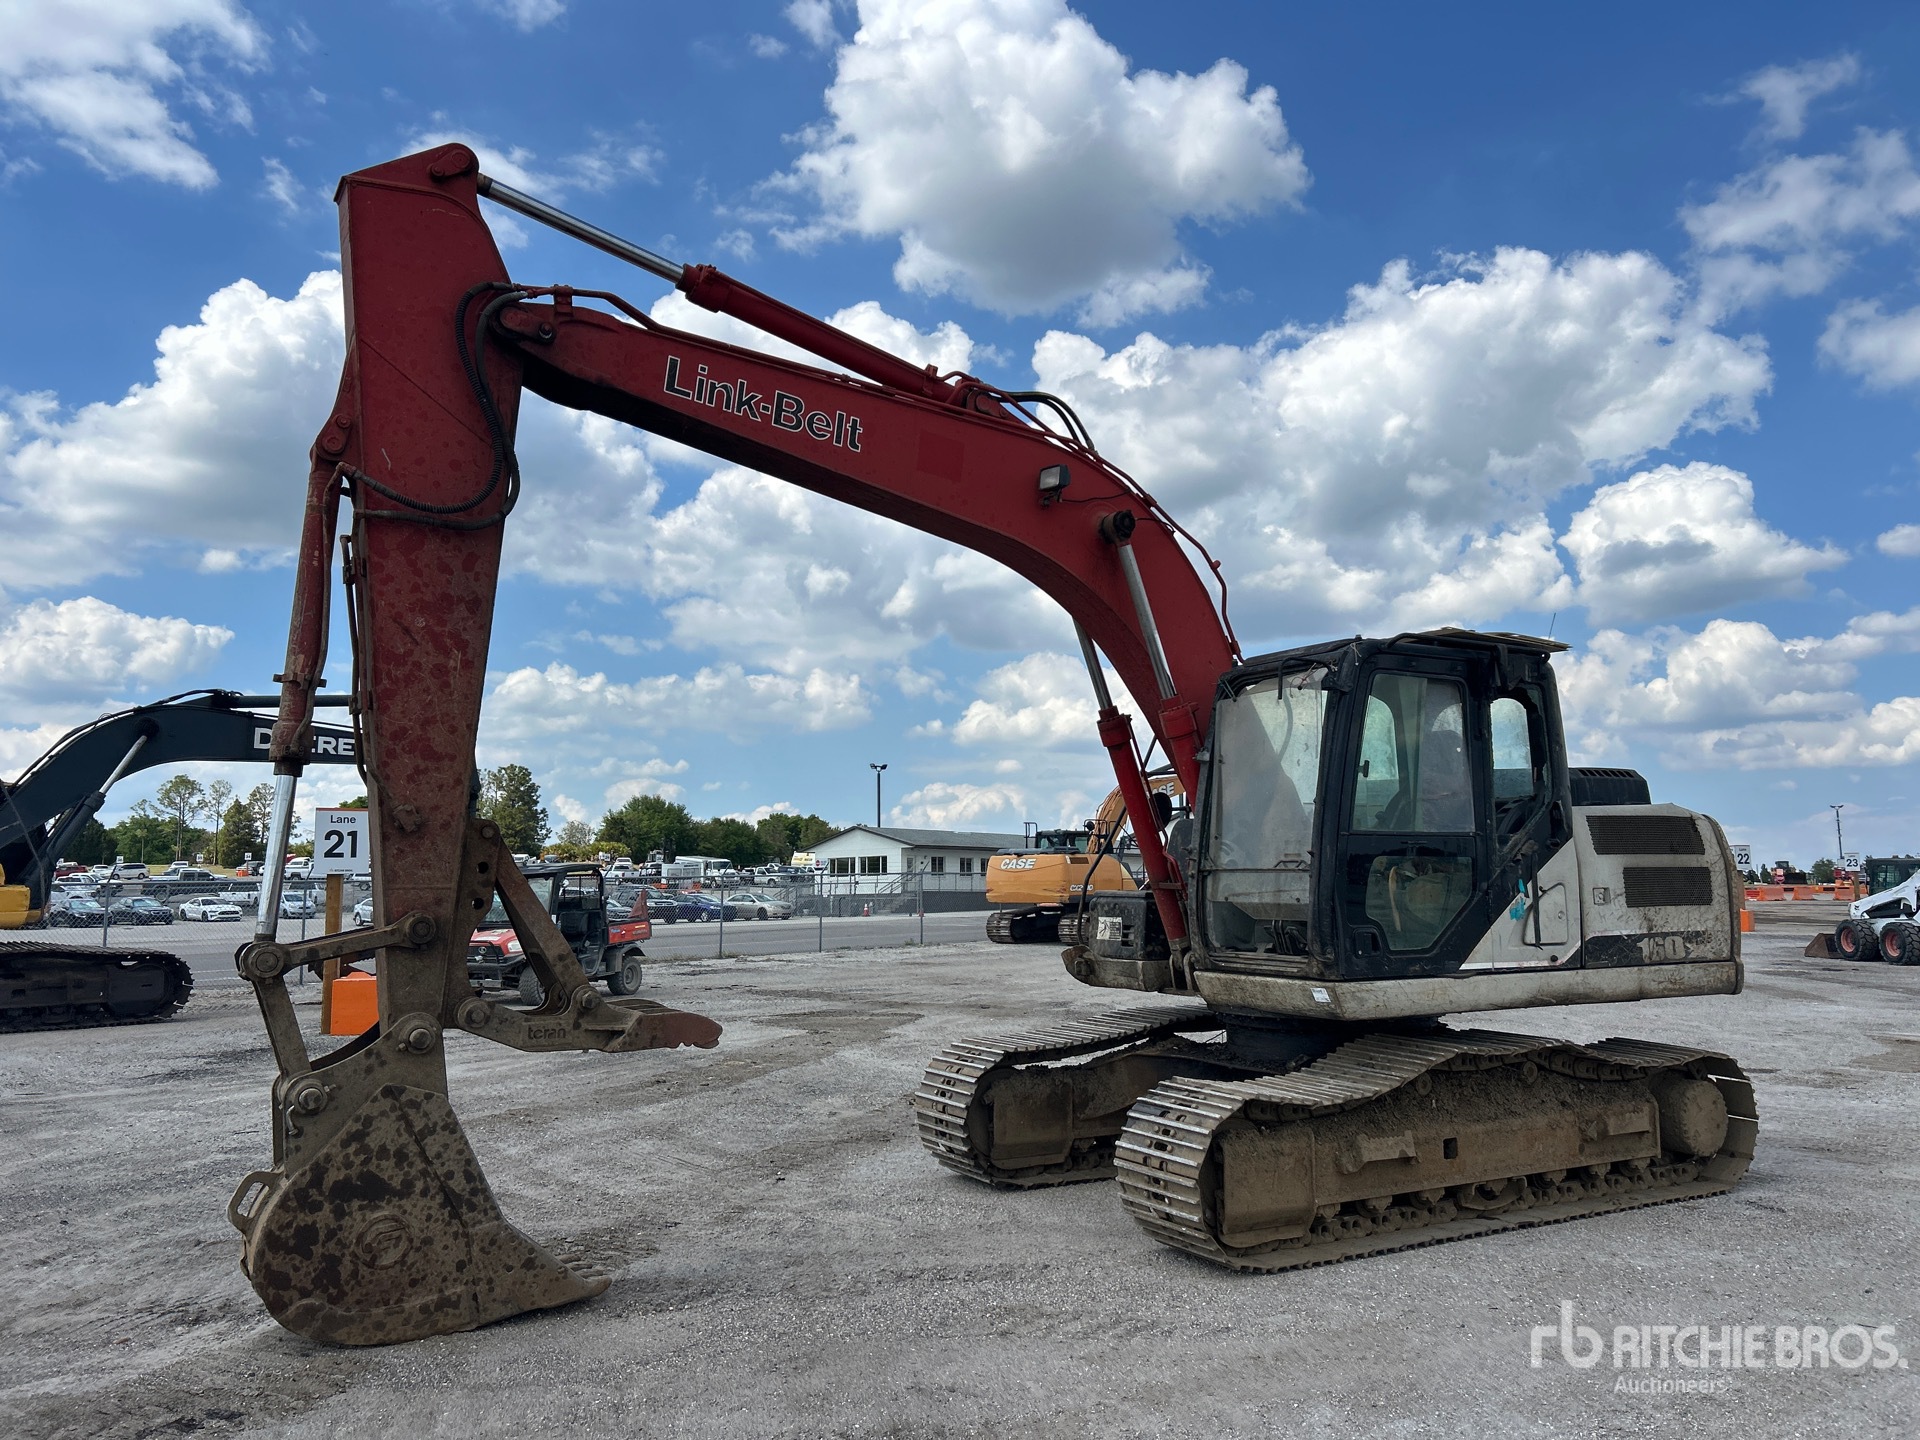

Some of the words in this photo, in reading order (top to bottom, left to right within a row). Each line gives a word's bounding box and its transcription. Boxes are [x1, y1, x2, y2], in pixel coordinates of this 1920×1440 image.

[664, 355, 863, 452] Link-Belt
[253, 727, 355, 756] DRE
[330, 814, 357, 824] Lane
[323, 829, 358, 858] 21
[1000, 858, 1037, 870] CASE
[1737, 853, 1750, 864] 22
[1846, 858, 1858, 867] 23
[527, 1024, 567, 1040] teran
